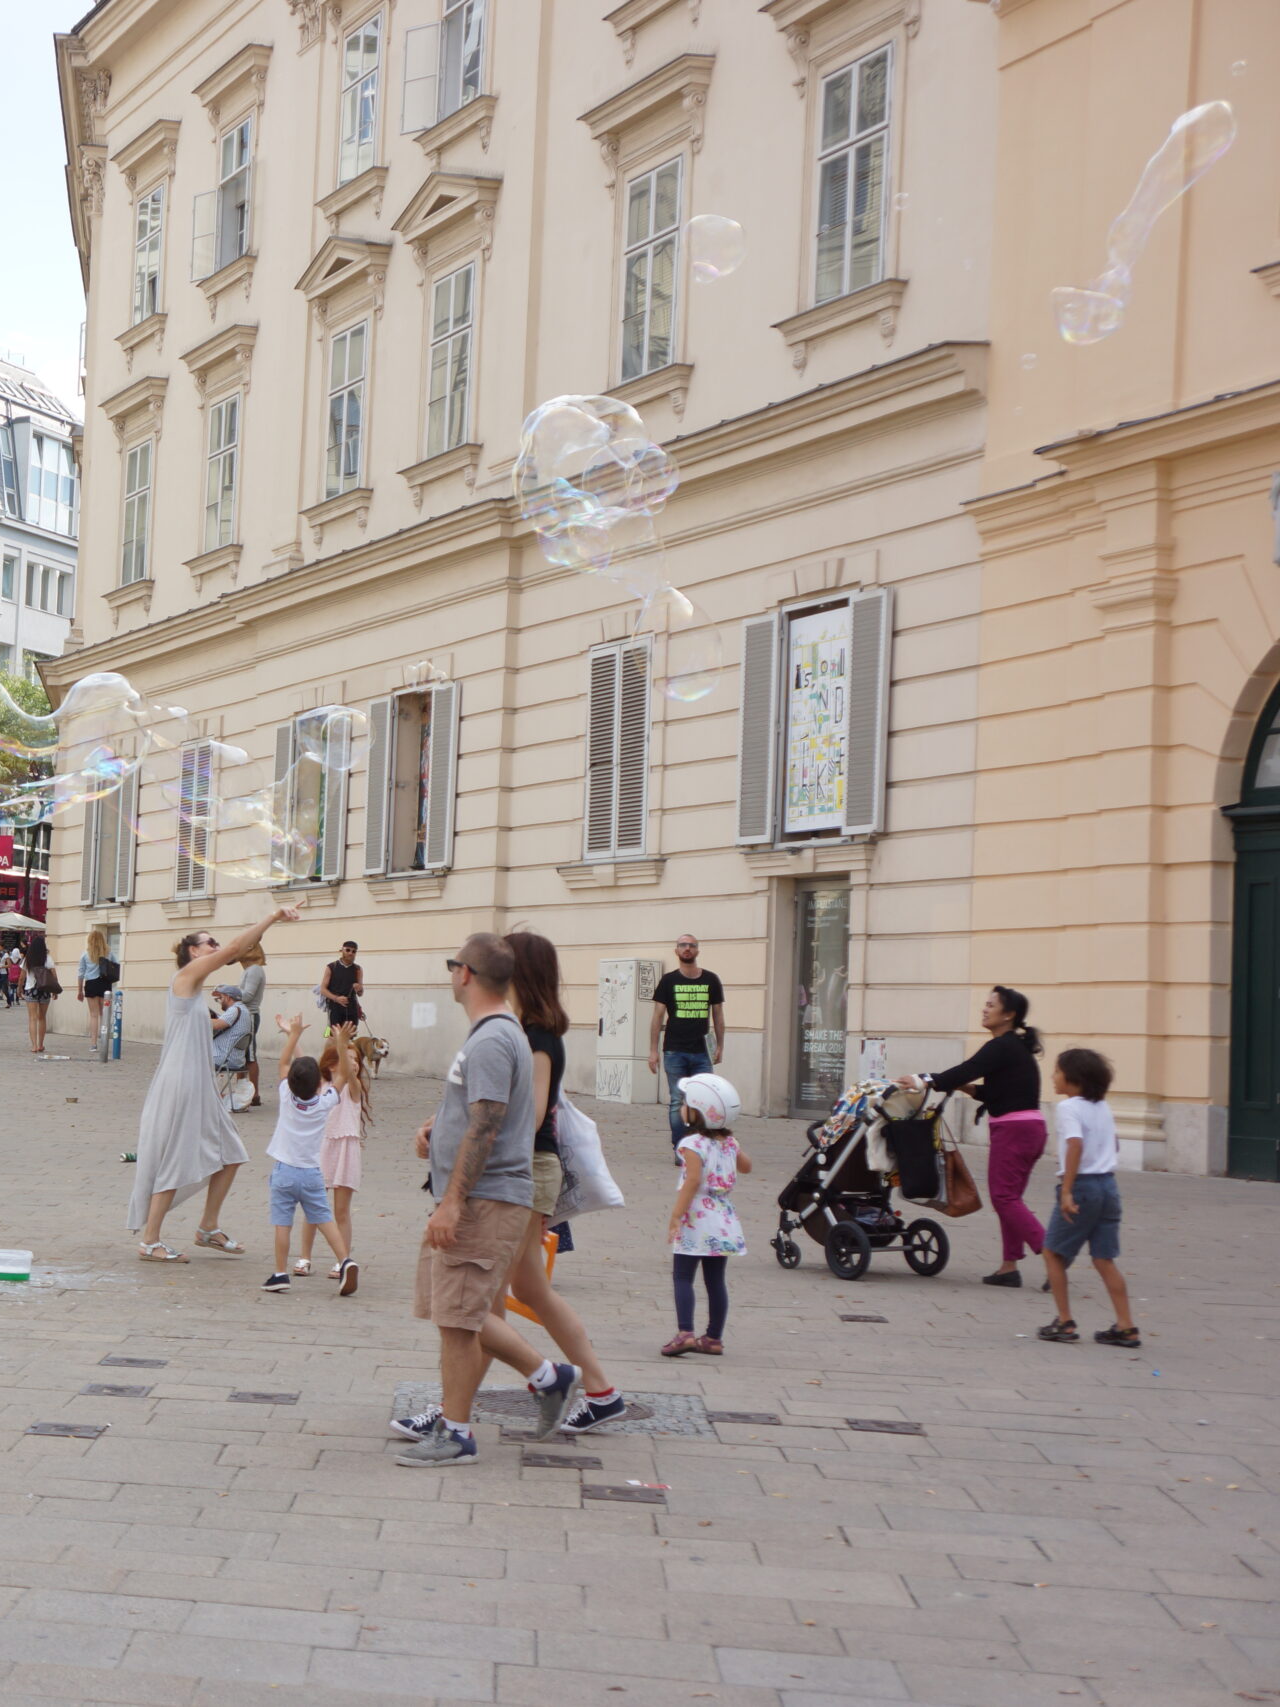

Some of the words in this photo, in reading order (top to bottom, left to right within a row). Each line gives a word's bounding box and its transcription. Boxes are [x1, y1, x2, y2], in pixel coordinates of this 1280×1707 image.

[674, 984, 709, 993] EVERYDAY
[689, 993, 697, 1001] IS
[676, 1001, 709, 1010] TRAINING
[686, 1009, 700, 1018] DAY
[804, 1029, 828, 1041] SHAKE
[829, 1030, 843, 1041] THE
[803, 1041, 827, 1053] BREAK
